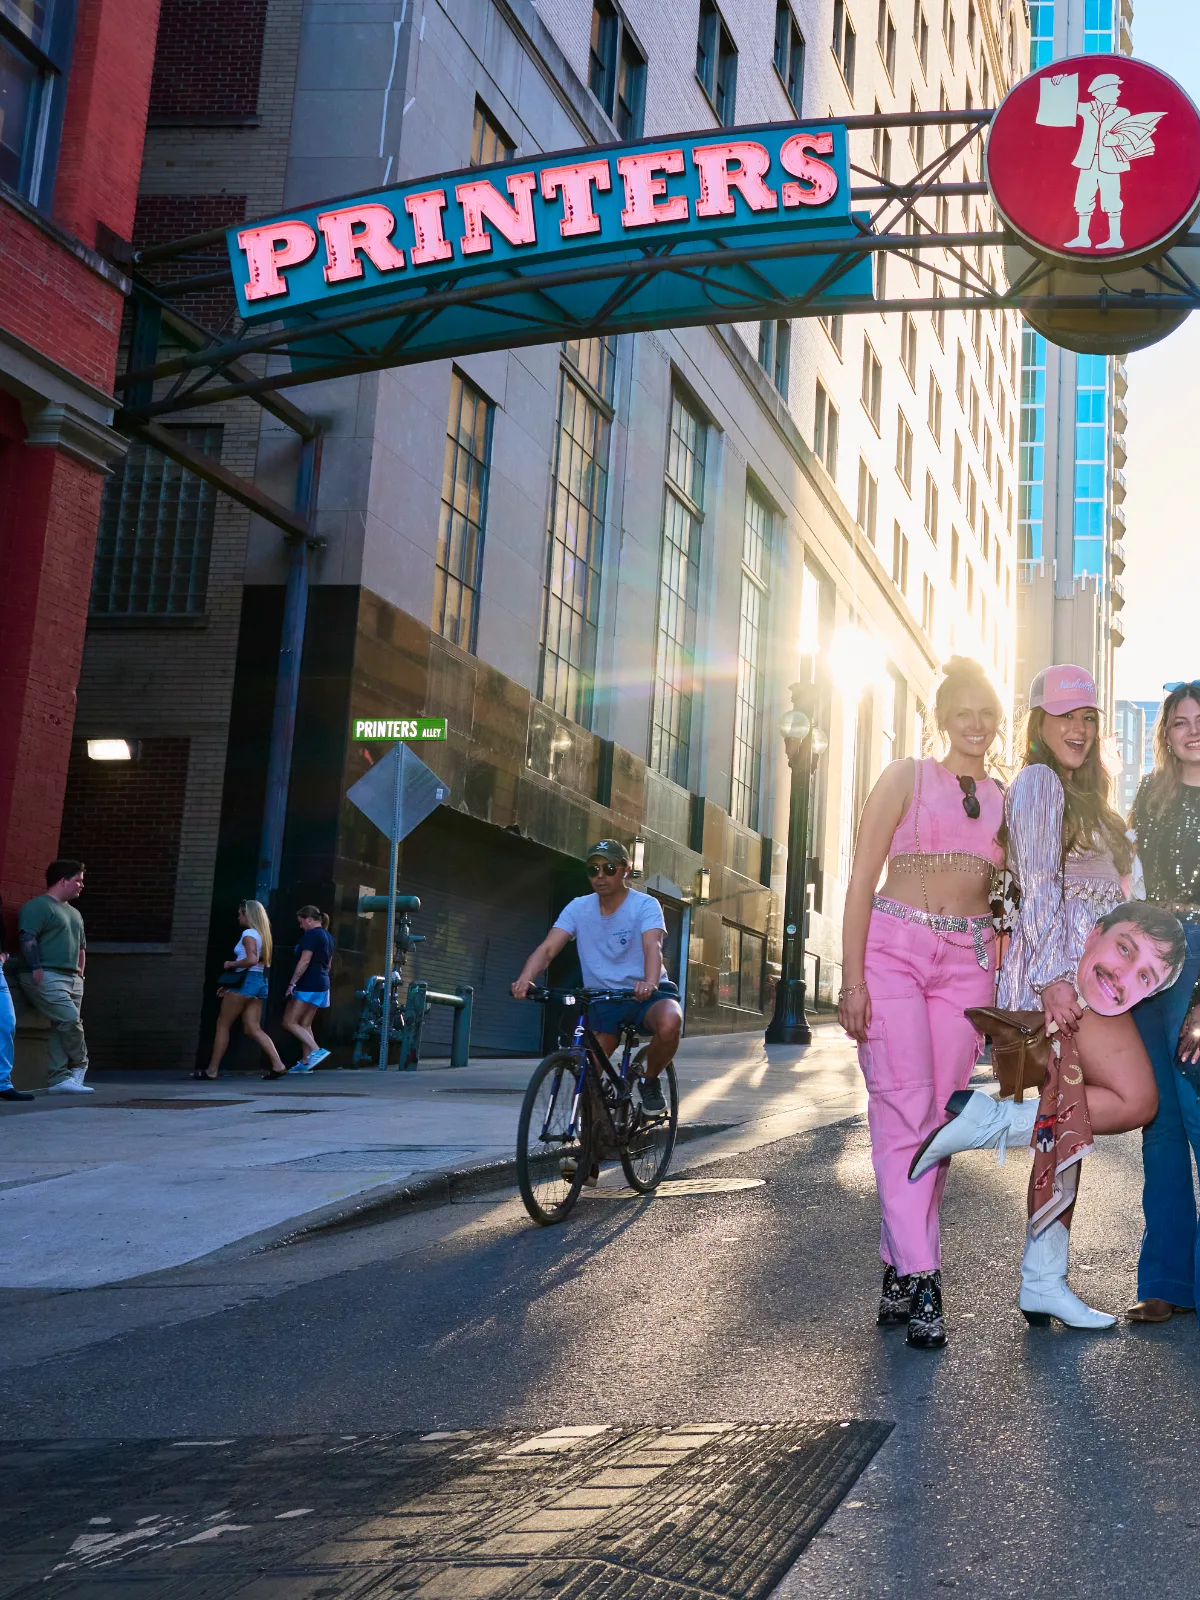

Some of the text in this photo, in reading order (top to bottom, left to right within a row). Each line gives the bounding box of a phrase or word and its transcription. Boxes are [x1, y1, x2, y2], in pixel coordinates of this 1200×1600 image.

[236, 131, 838, 303] PRINTERS
[355, 720, 441, 738] PRINTERS ALLEY
